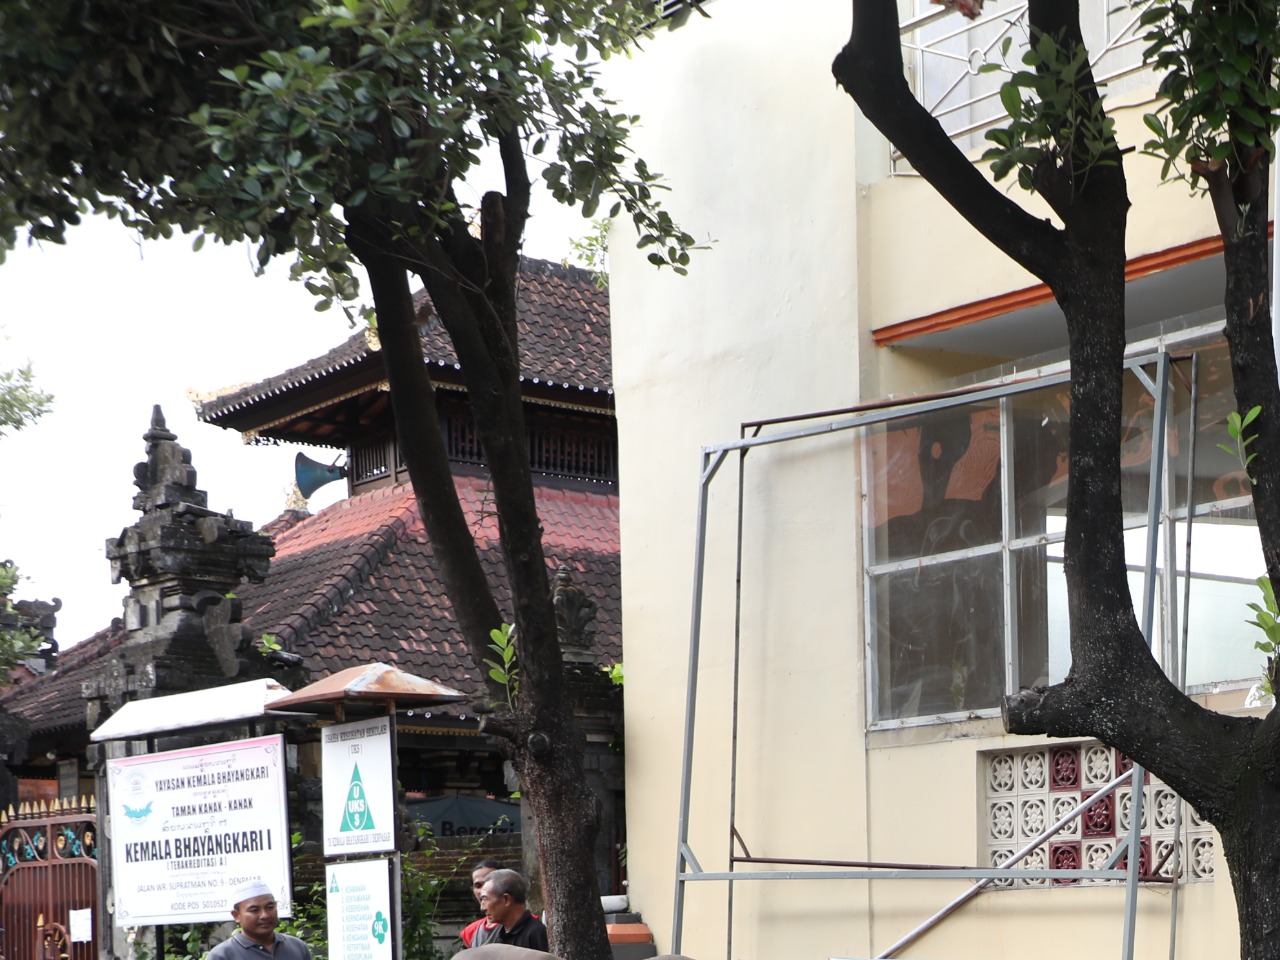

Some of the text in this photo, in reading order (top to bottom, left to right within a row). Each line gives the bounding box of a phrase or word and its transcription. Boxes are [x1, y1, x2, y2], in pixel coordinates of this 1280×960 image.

[155, 777, 185, 792] YAYASAN
[188, 773, 216, 788] KEMALA
[217, 766, 269, 784] BHAYANGKARI
[353, 786, 360, 798] U
[172, 805, 197, 818] TAMAN
[198, 801, 223, 814] KANAK
[228, 798, 254, 811] KANAK
[348, 800, 365, 814] UKS
[354, 814, 360, 827] S
[126, 829, 272, 862] KEMALA BHAYANGKARI I
[167, 857, 217, 870] (TERAKREDITASI
[138, 884, 155, 892] JALAN
[169, 880, 206, 891] SUPRATMAN
[208, 879, 218, 888] NO.
[220, 878, 224, 886] 9
[170, 902, 186, 911] KODE
[188, 901, 200, 910] POS
[374, 921, 384, 935] 9K
